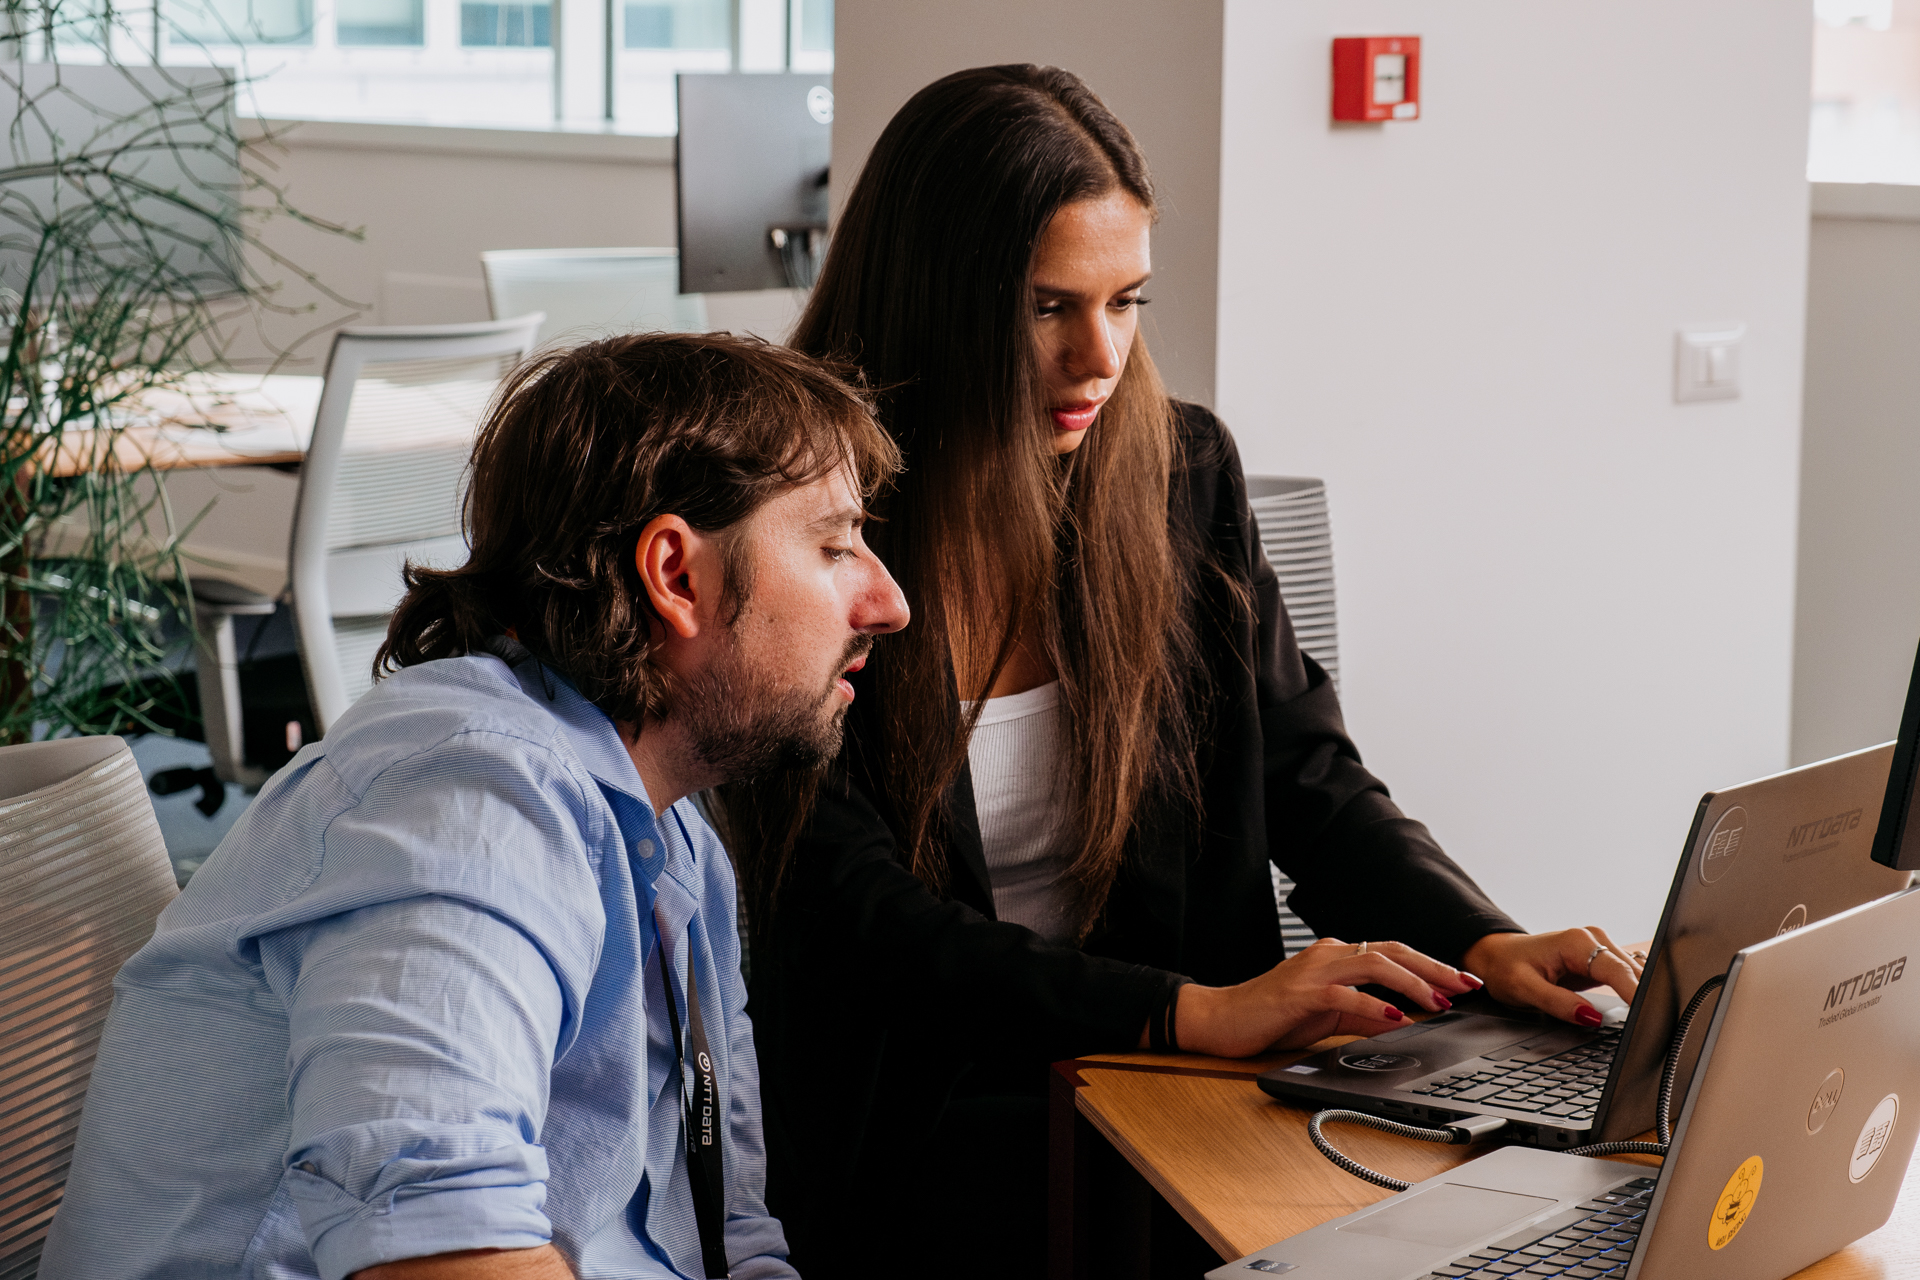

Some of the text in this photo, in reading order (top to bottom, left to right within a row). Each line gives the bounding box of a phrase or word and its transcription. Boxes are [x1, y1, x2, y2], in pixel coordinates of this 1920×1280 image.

[1786, 820, 1822, 848] NTT
[1823, 974, 1863, 1011] NTT
[703, 1075, 712, 1104] NTT
